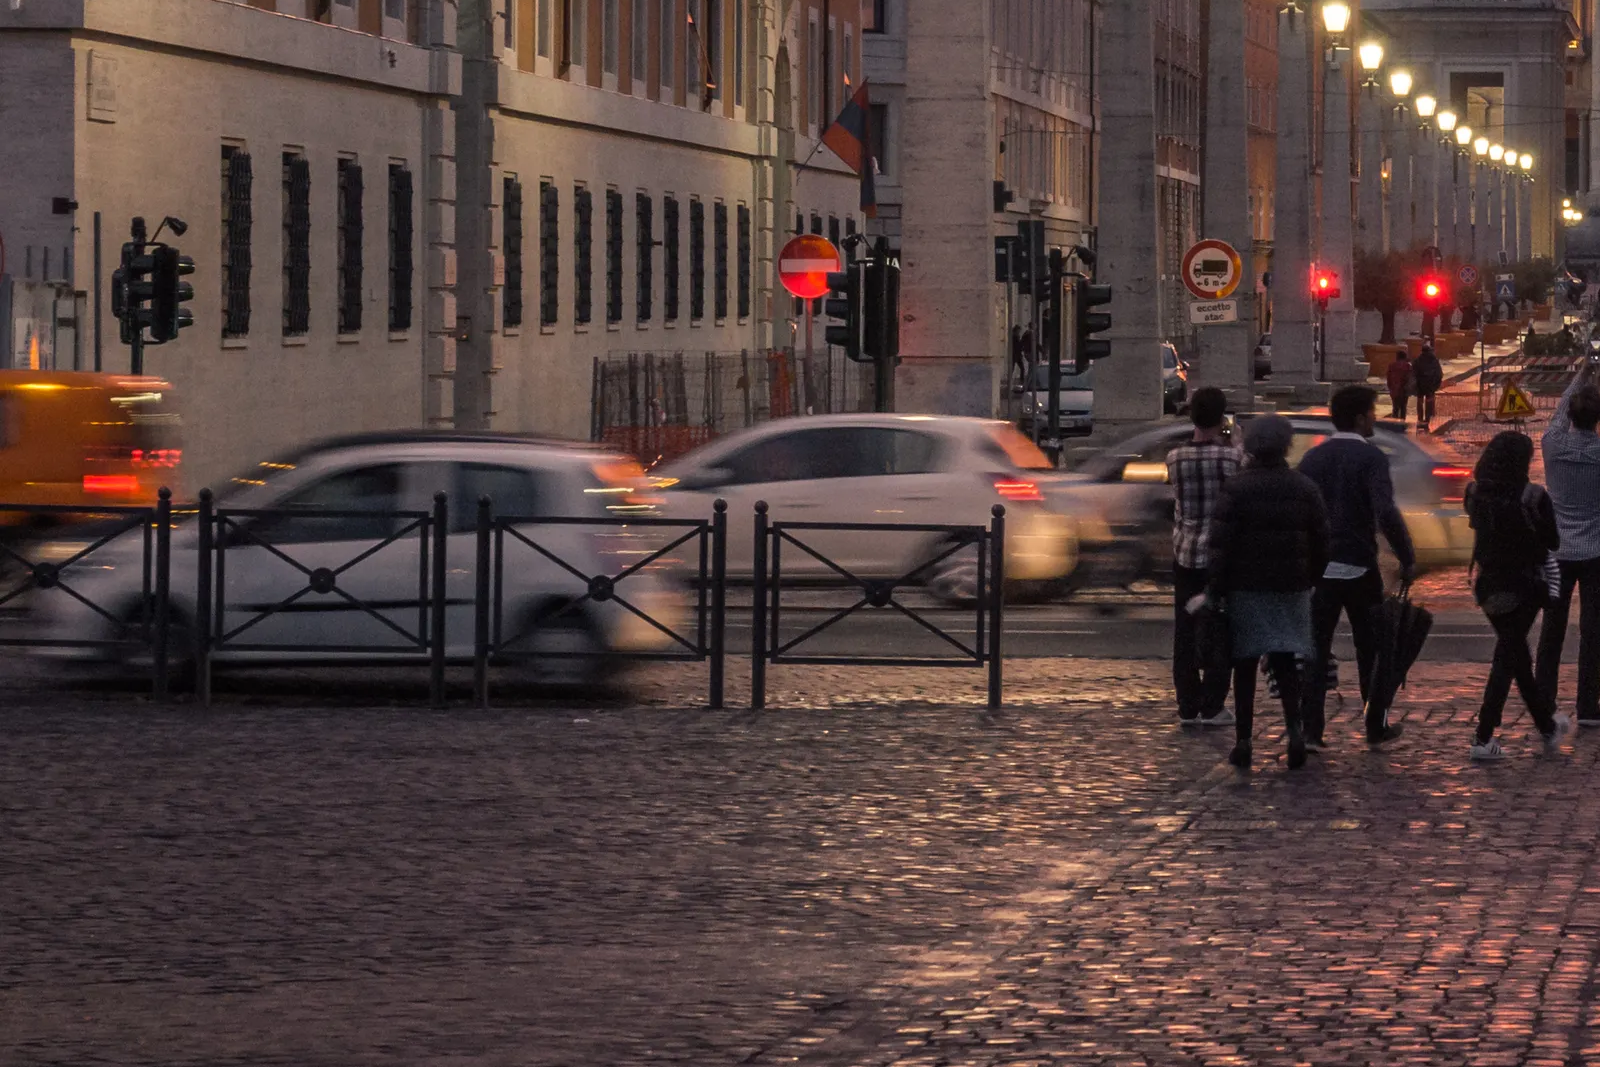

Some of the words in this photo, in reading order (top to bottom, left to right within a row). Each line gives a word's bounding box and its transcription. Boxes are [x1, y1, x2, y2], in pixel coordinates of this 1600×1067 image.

[1204, 278, 1209, 286] 6
[1196, 302, 1231, 313] eccetto
[1204, 313, 1225, 322] atac
